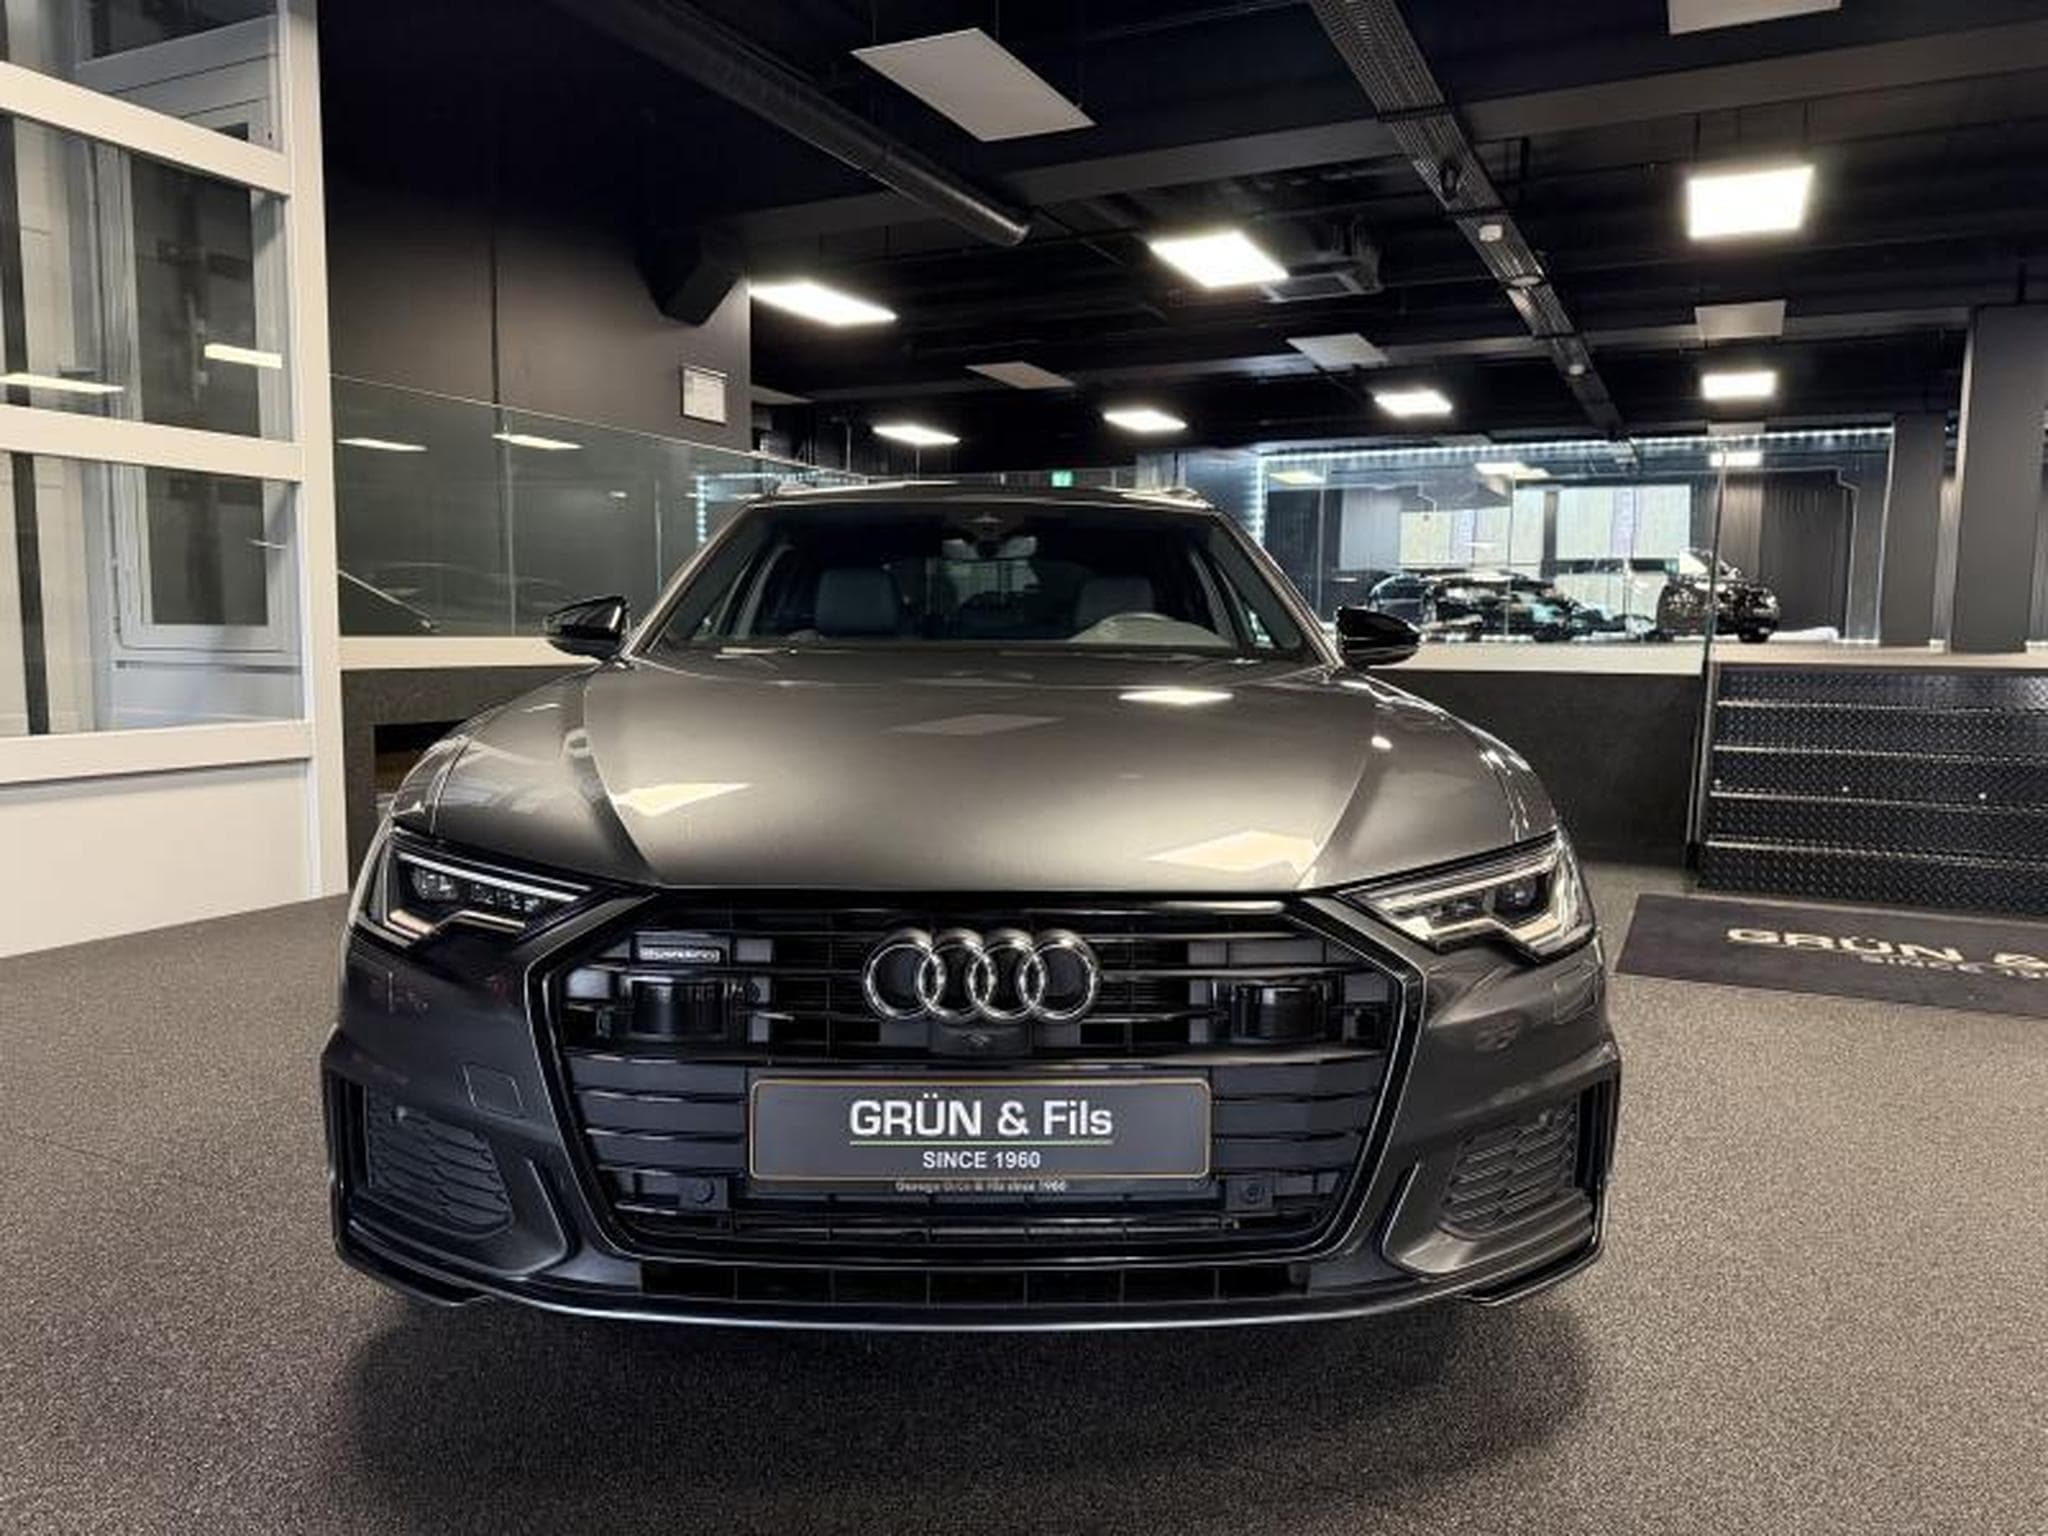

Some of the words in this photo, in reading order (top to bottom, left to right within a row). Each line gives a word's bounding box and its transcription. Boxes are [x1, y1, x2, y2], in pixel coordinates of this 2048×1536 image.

[1726, 928, 1964, 962] GRÜN
[850, 1092, 982, 1136] GRÜN
[997, 1100, 1030, 1136] &
[1043, 1100, 1114, 1136] Fils
[922, 1151, 988, 1169] SINCE
[994, 1151, 1042, 1169] 1960
